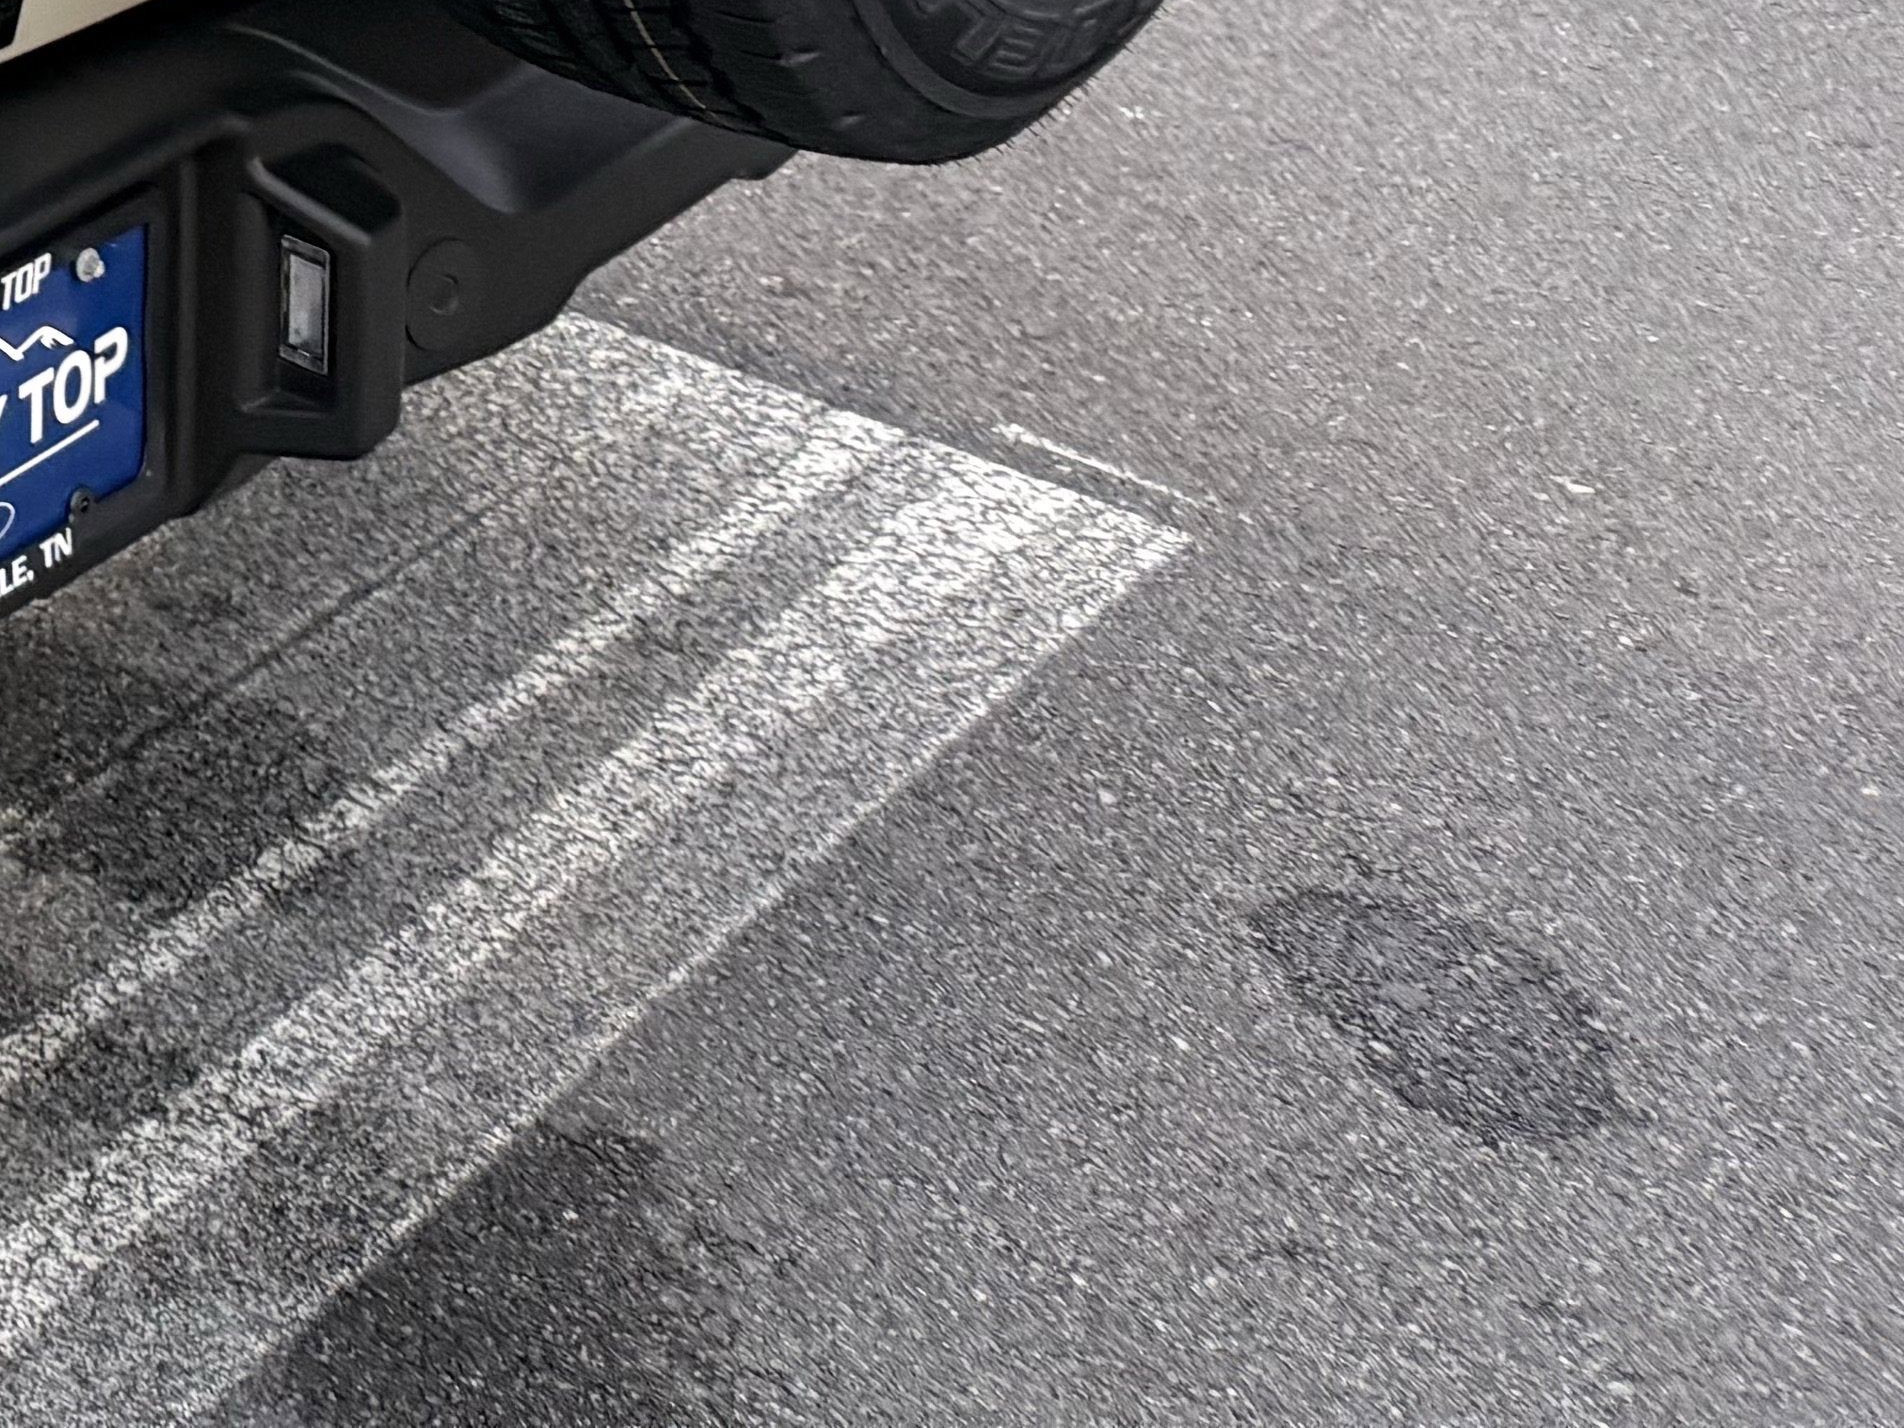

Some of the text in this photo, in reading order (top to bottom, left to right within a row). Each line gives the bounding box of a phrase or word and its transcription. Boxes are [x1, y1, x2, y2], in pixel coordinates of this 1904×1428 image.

[0, 252, 52, 311] TOP
[18, 326, 129, 445] TOP
[39, 526, 73, 569] TN
